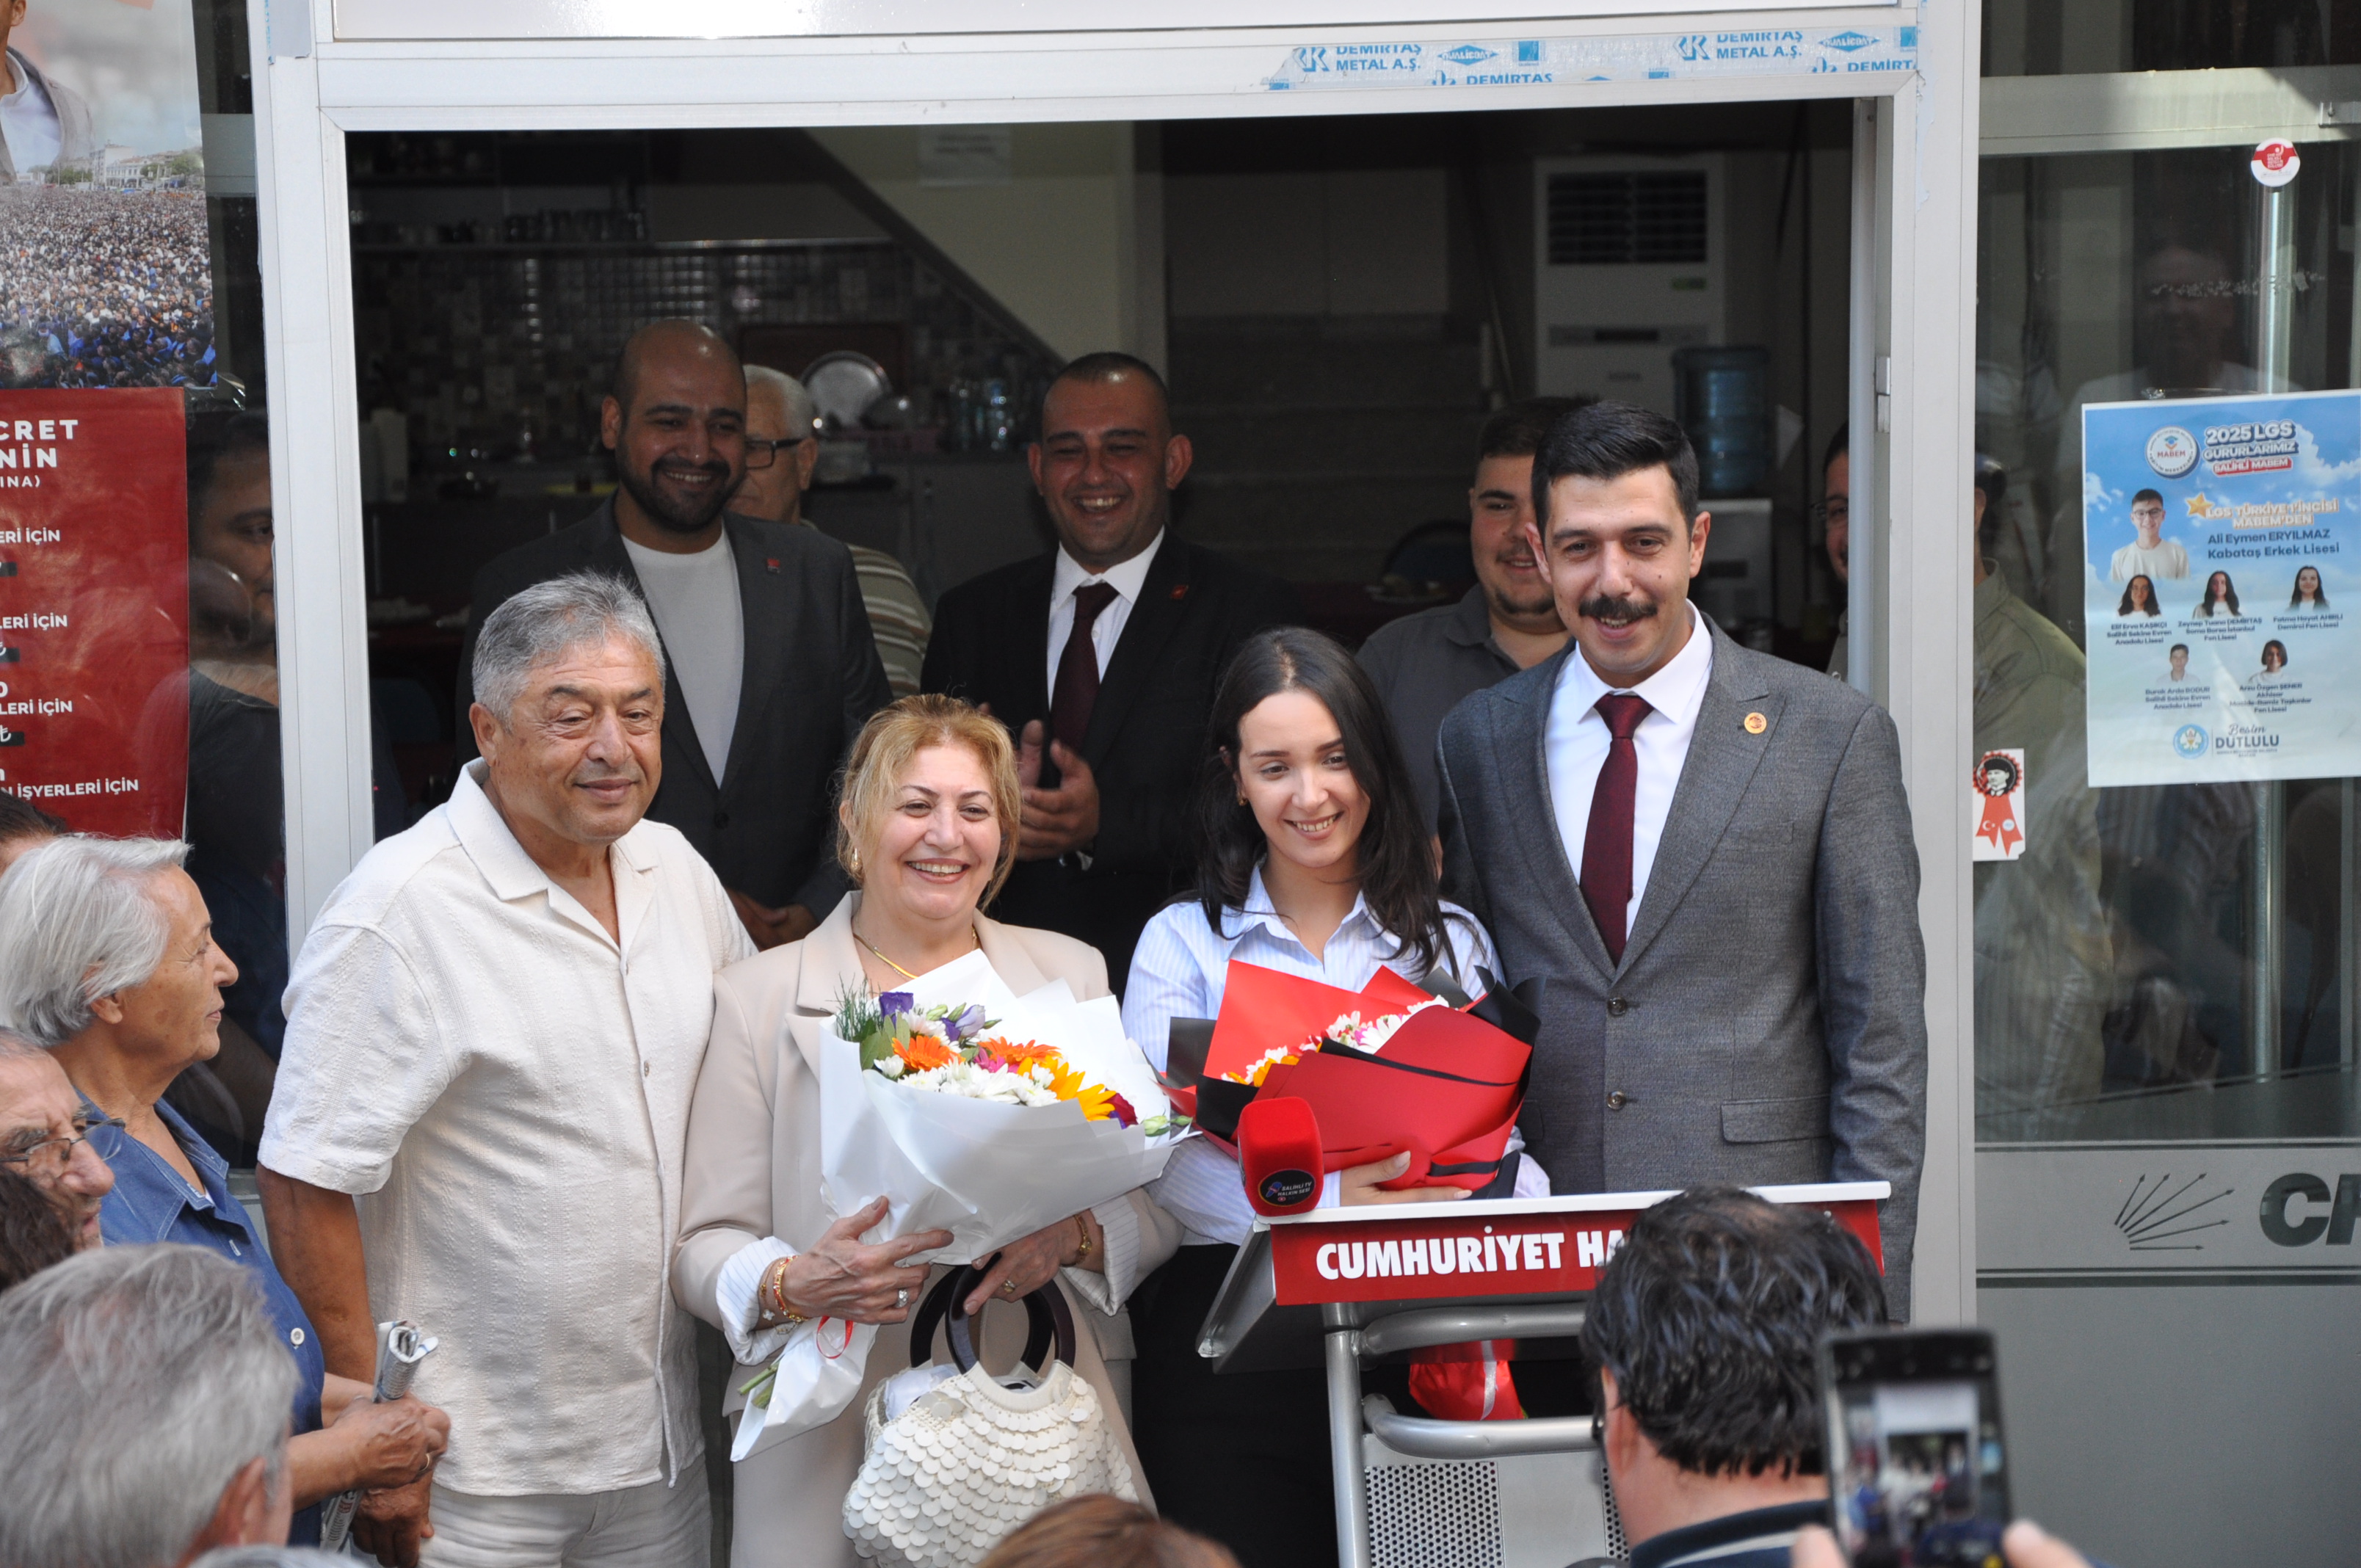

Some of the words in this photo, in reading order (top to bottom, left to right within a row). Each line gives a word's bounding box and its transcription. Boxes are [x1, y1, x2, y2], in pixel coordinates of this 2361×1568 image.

[1716, 47, 1769, 59] METAL
[1773, 46, 1802, 59] A.Ş.
[1336, 59, 1388, 70] METAL
[1392, 58, 1421, 72] A.Ş.
[0, 419, 79, 440] CRET
[2205, 425, 2252, 445] 2025
[2254, 421, 2294, 440] LGS
[0, 443, 57, 469] NİN
[2157, 450, 2186, 458] MABEM
[2203, 441, 2296, 461] GURURLARIMIZ
[2214, 459, 2249, 472] SALİHLİ
[2252, 457, 2288, 470] MABEM
[2206, 507, 2233, 519] LGS
[2235, 501, 2288, 517] TÜRKİYE
[26, 527, 60, 545] İÇİN
[2208, 533, 2223, 545] Ali
[2225, 534, 2266, 545] Eymen
[2268, 529, 2330, 541] ERYILMAZ
[2208, 548, 2261, 559] Kabataş
[2265, 545, 2300, 556] Erkek
[2304, 542, 2340, 555] Lisesi
[0, 614, 29, 629] ERİ
[33, 612, 68, 631] İÇİN
[38, 698, 73, 716] İÇİN
[2216, 734, 2280, 749] DUTLULU
[18, 779, 101, 801] İŞYERLERİ
[105, 777, 139, 794] İÇİN
[1316, 1225, 1564, 1280] CUMHURİYET
